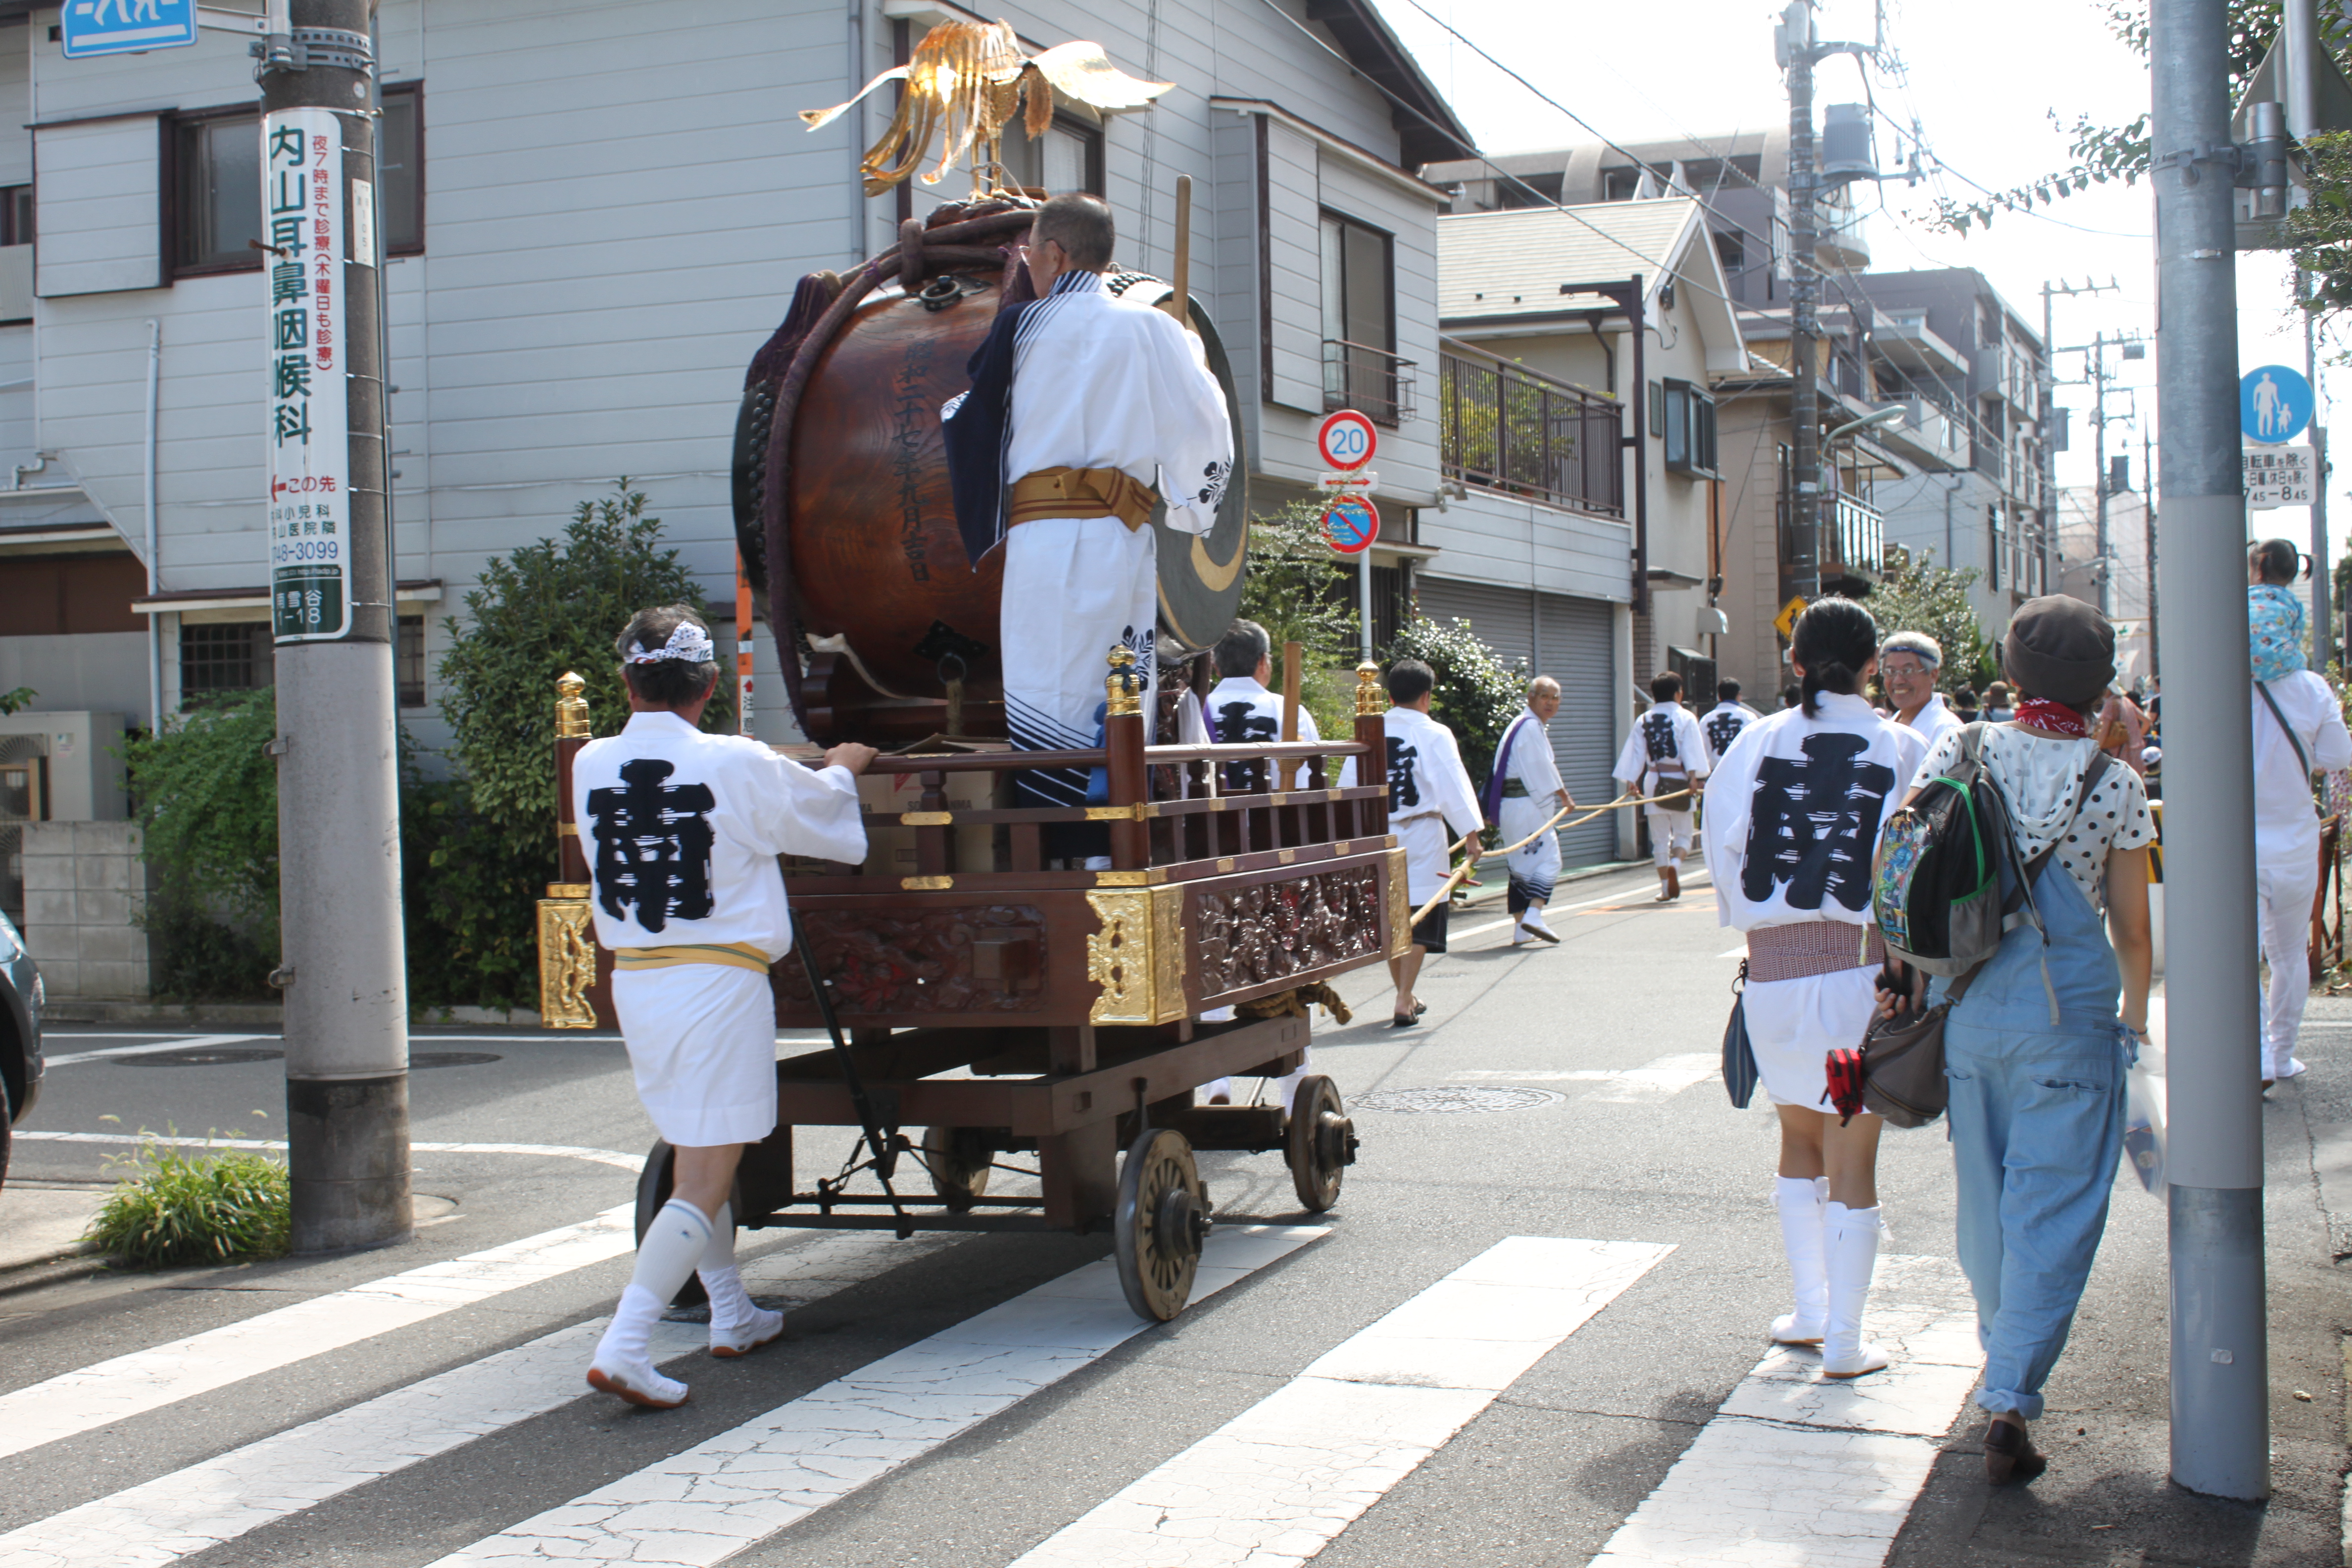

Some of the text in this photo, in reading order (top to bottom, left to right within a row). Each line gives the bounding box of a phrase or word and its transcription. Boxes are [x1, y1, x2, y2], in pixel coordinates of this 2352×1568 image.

[1332, 429, 1364, 454] 20
[288, 476, 336, 494] この先
[277, 607, 321, 626] 1-18
